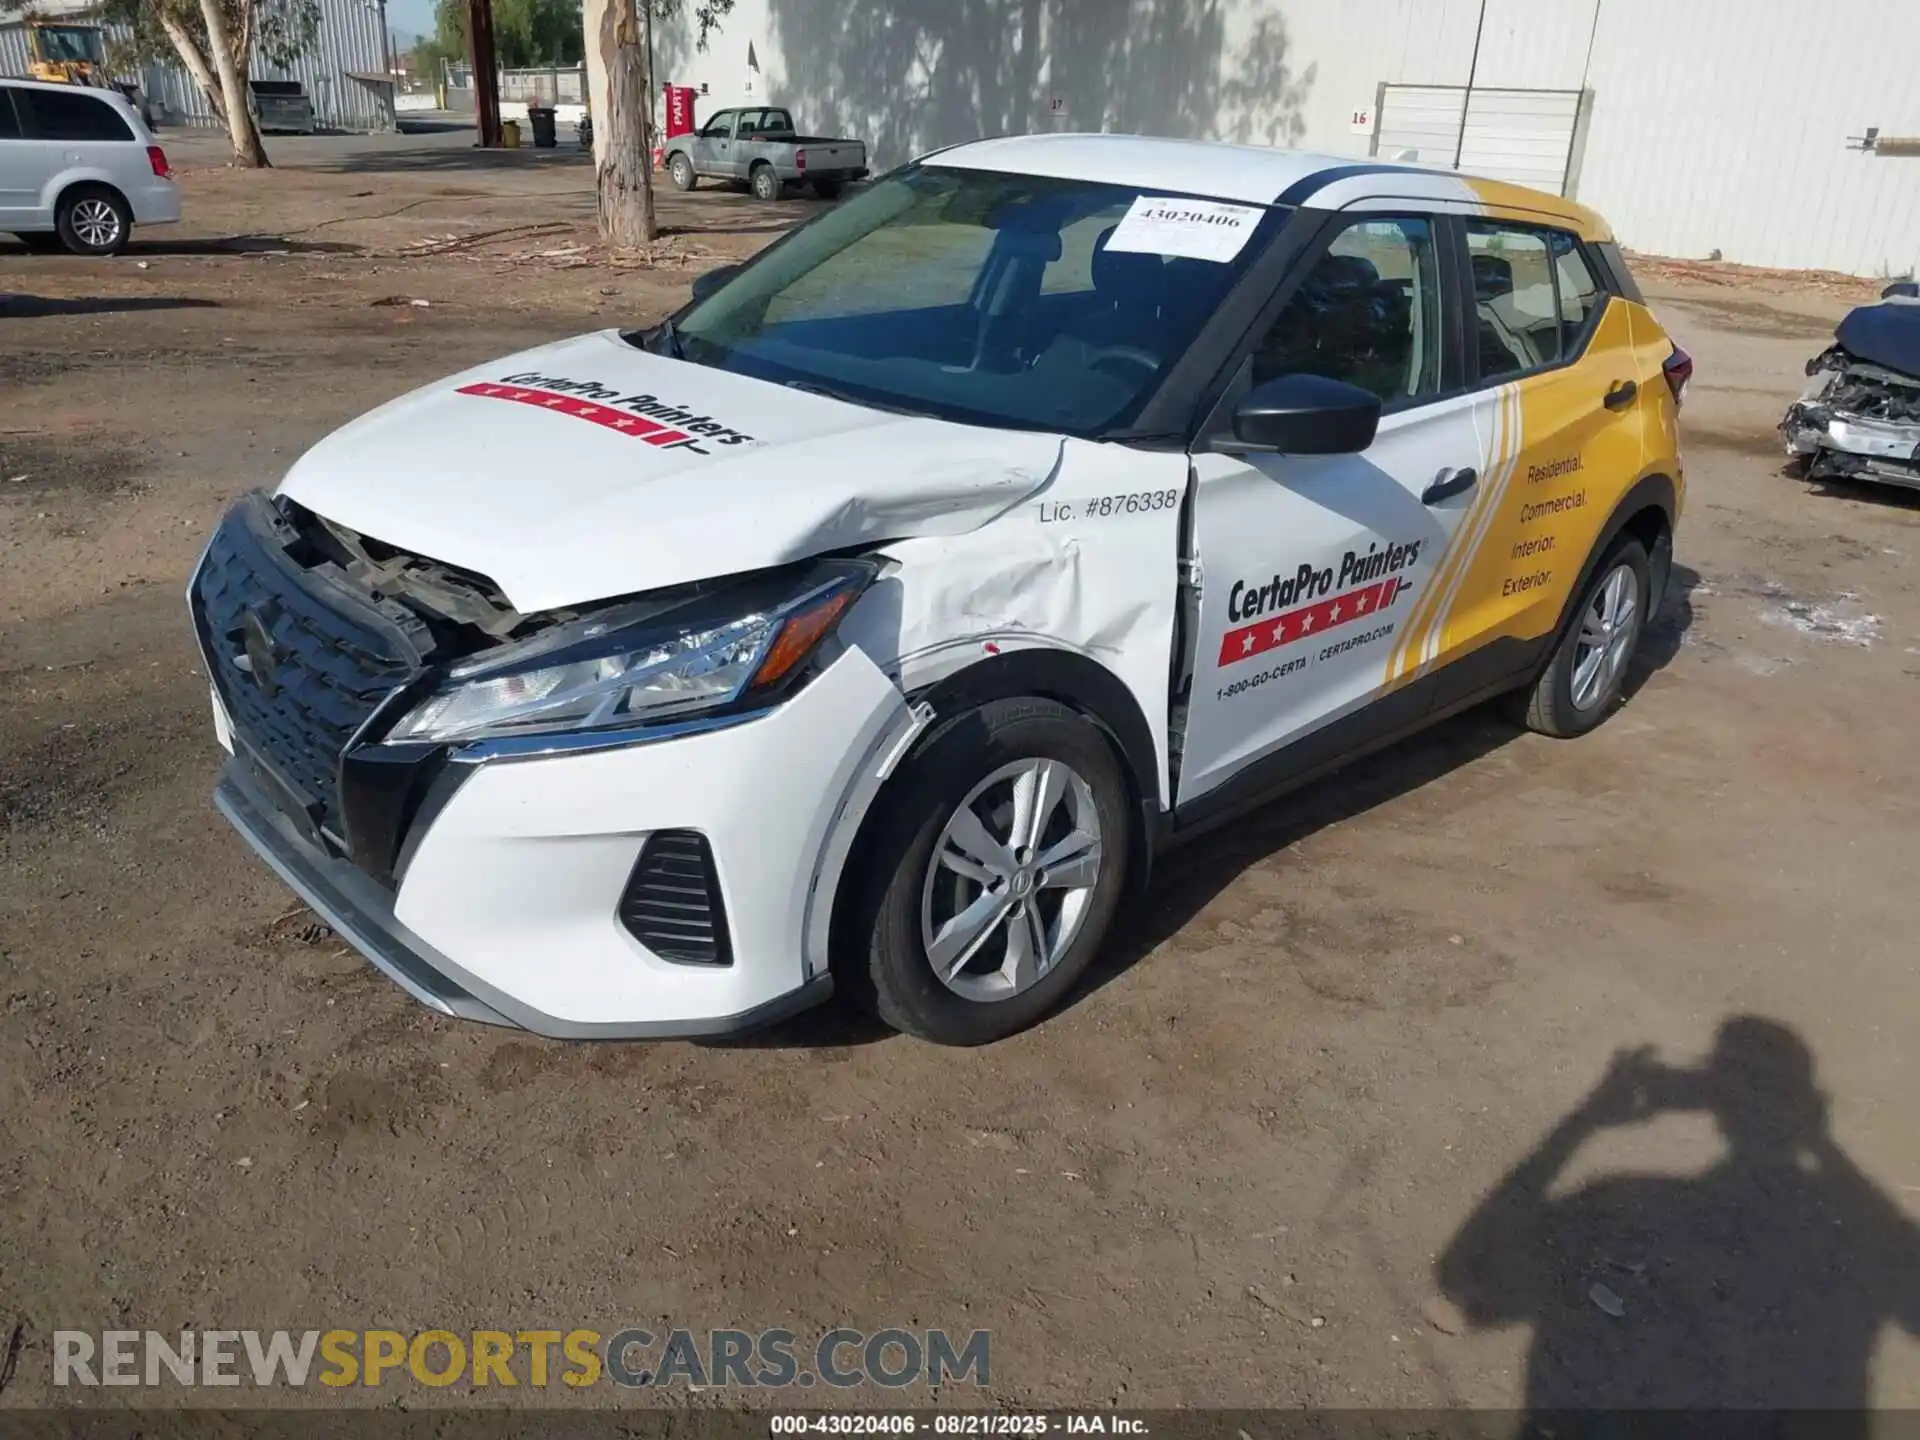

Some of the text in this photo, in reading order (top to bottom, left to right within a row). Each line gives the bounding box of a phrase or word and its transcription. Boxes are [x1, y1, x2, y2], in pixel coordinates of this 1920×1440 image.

[1352, 111, 1367, 124] 16
[1140, 208, 1240, 228] 43020406
[500, 371, 754, 446] CertaPro Painters
[1527, 452, 1585, 485] Residential.
[1039, 488, 1178, 523] Lic. #876338
[1519, 487, 1588, 524] Commercial.
[1511, 534, 1556, 561] Interior.
[1228, 539, 1421, 624] CertaPro Painters
[1502, 569, 1553, 597] Exterior.
[1216, 656, 1307, 702] 1-800-GO-CERTA
[1319, 622, 1395, 662] CERTAPRO.COM
